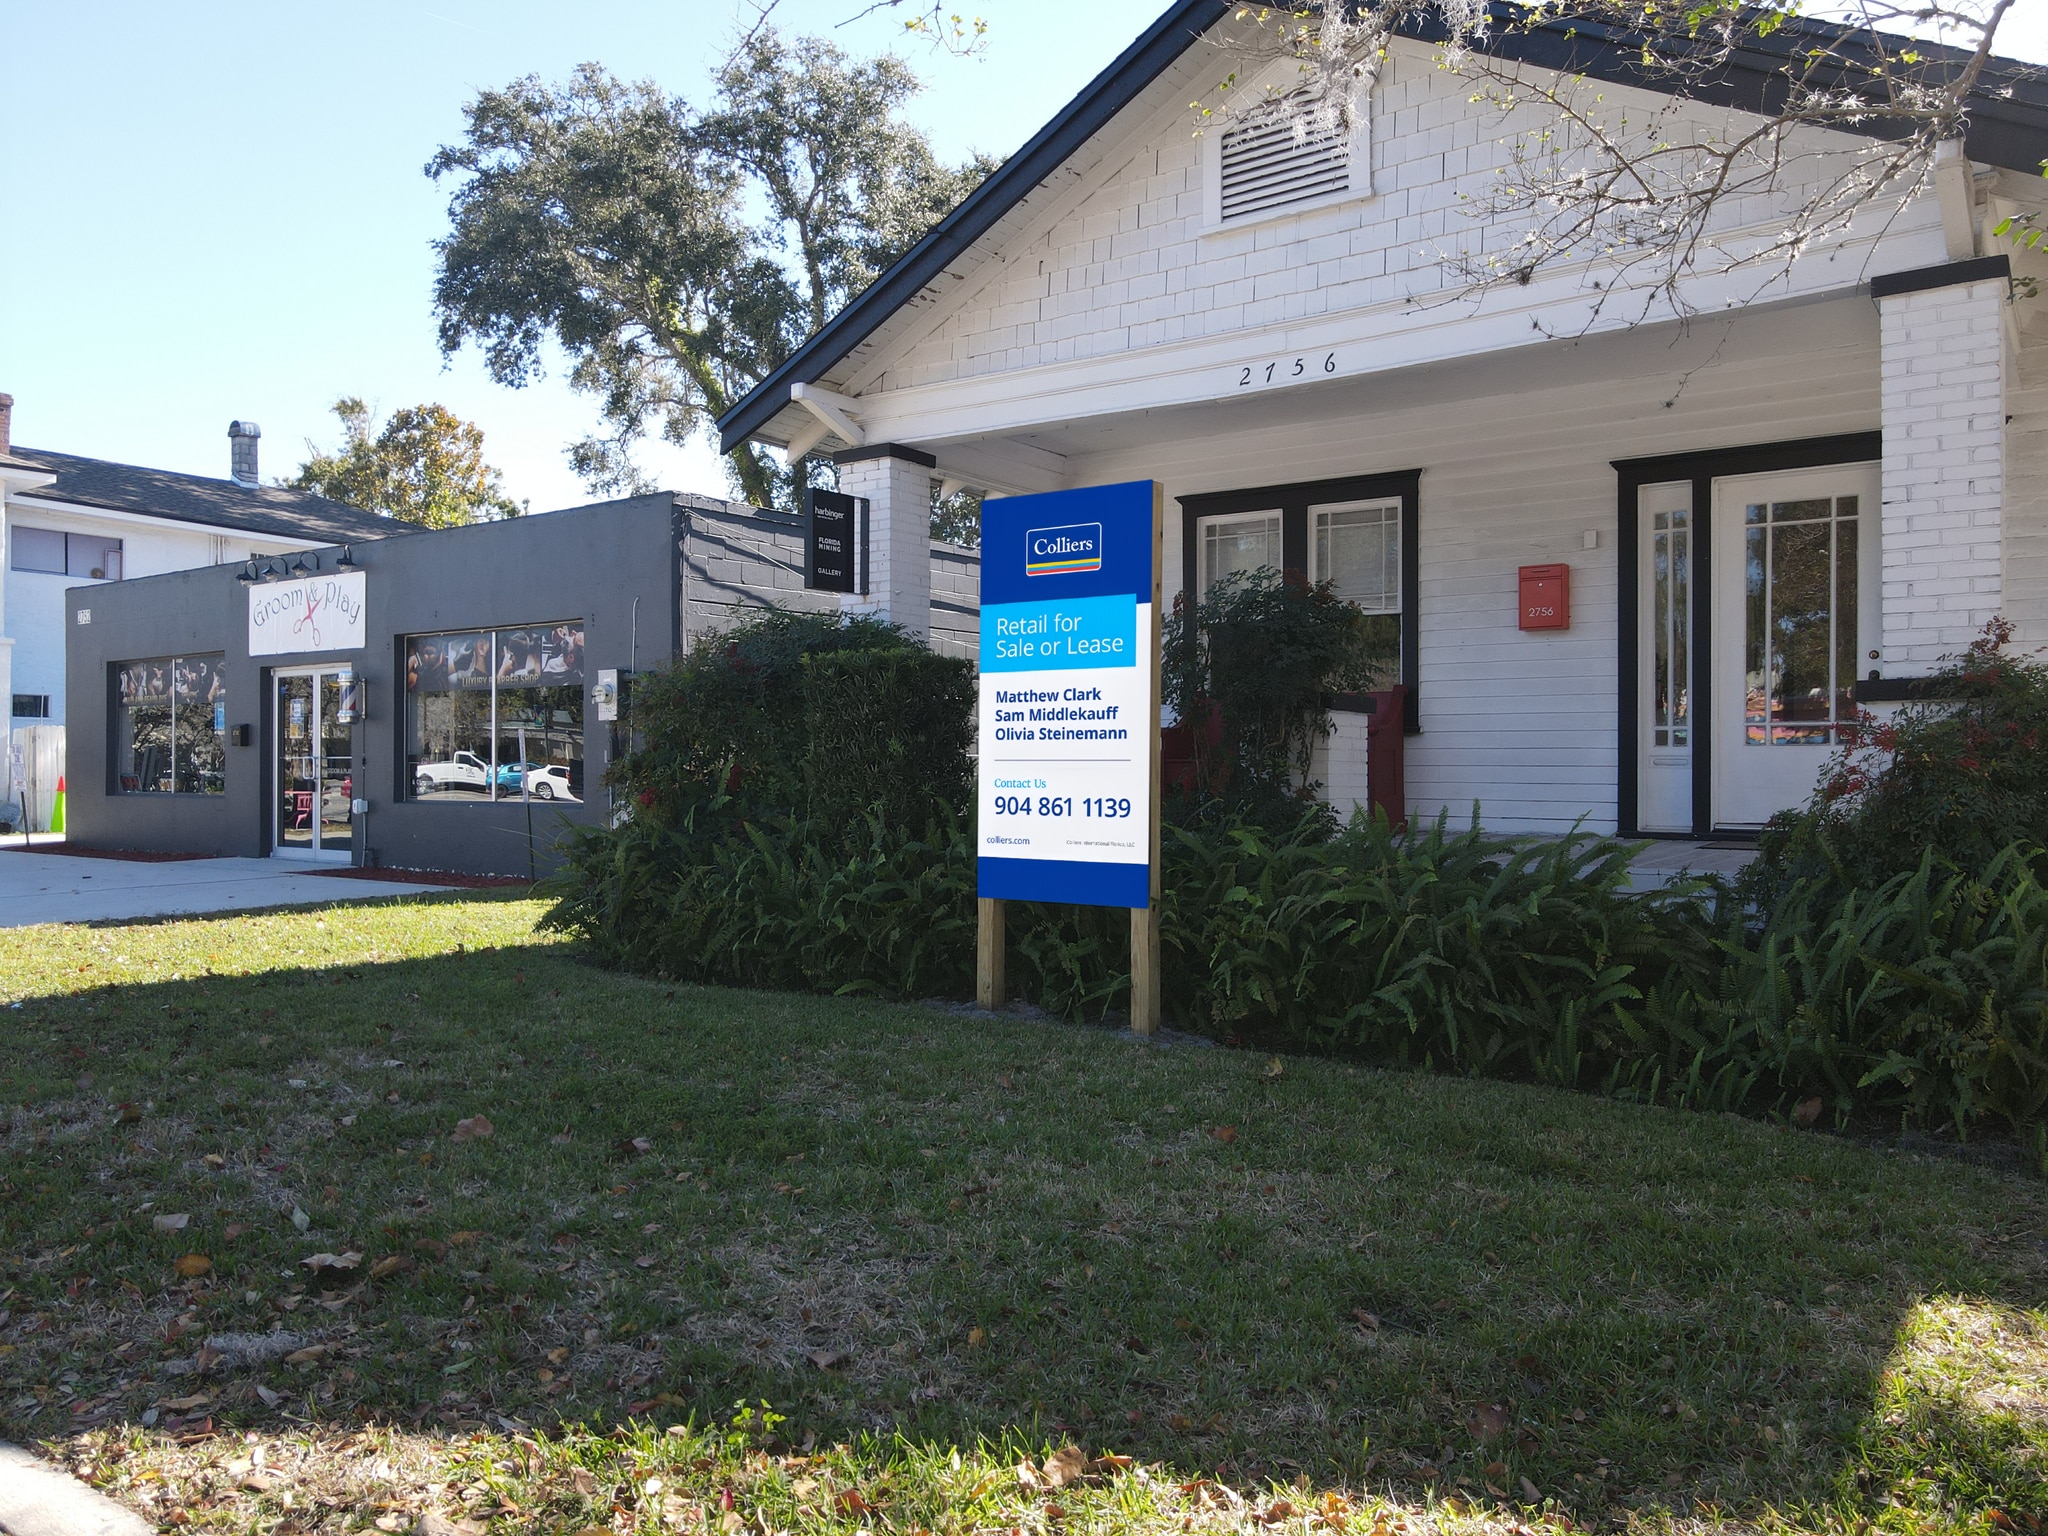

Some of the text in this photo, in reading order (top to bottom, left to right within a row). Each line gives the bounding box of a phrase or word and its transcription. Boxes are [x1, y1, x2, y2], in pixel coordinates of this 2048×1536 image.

[1239, 352, 1335, 386] 2756
[815, 506, 844, 520] harbinger
[818, 537, 841, 546] FLORIDA
[818, 543, 841, 552] MINING
[1034, 537, 1093, 554] Colliers
[817, 567, 842, 577] GALLERY
[253, 581, 361, 627] Groom & Play
[1528, 607, 1554, 617] 2756
[996, 613, 1082, 636] Retail for
[996, 636, 1124, 658] Sale or Lease
[996, 687, 1102, 703] Matthew Clark
[995, 706, 1119, 722] Sam Middlekauff
[995, 727, 1128, 741] Olivia Steinemann
[994, 778, 1047, 789] Contact Us
[994, 796, 1131, 818] 904 861 1139
[986, 836, 1030, 845] colliers.com
